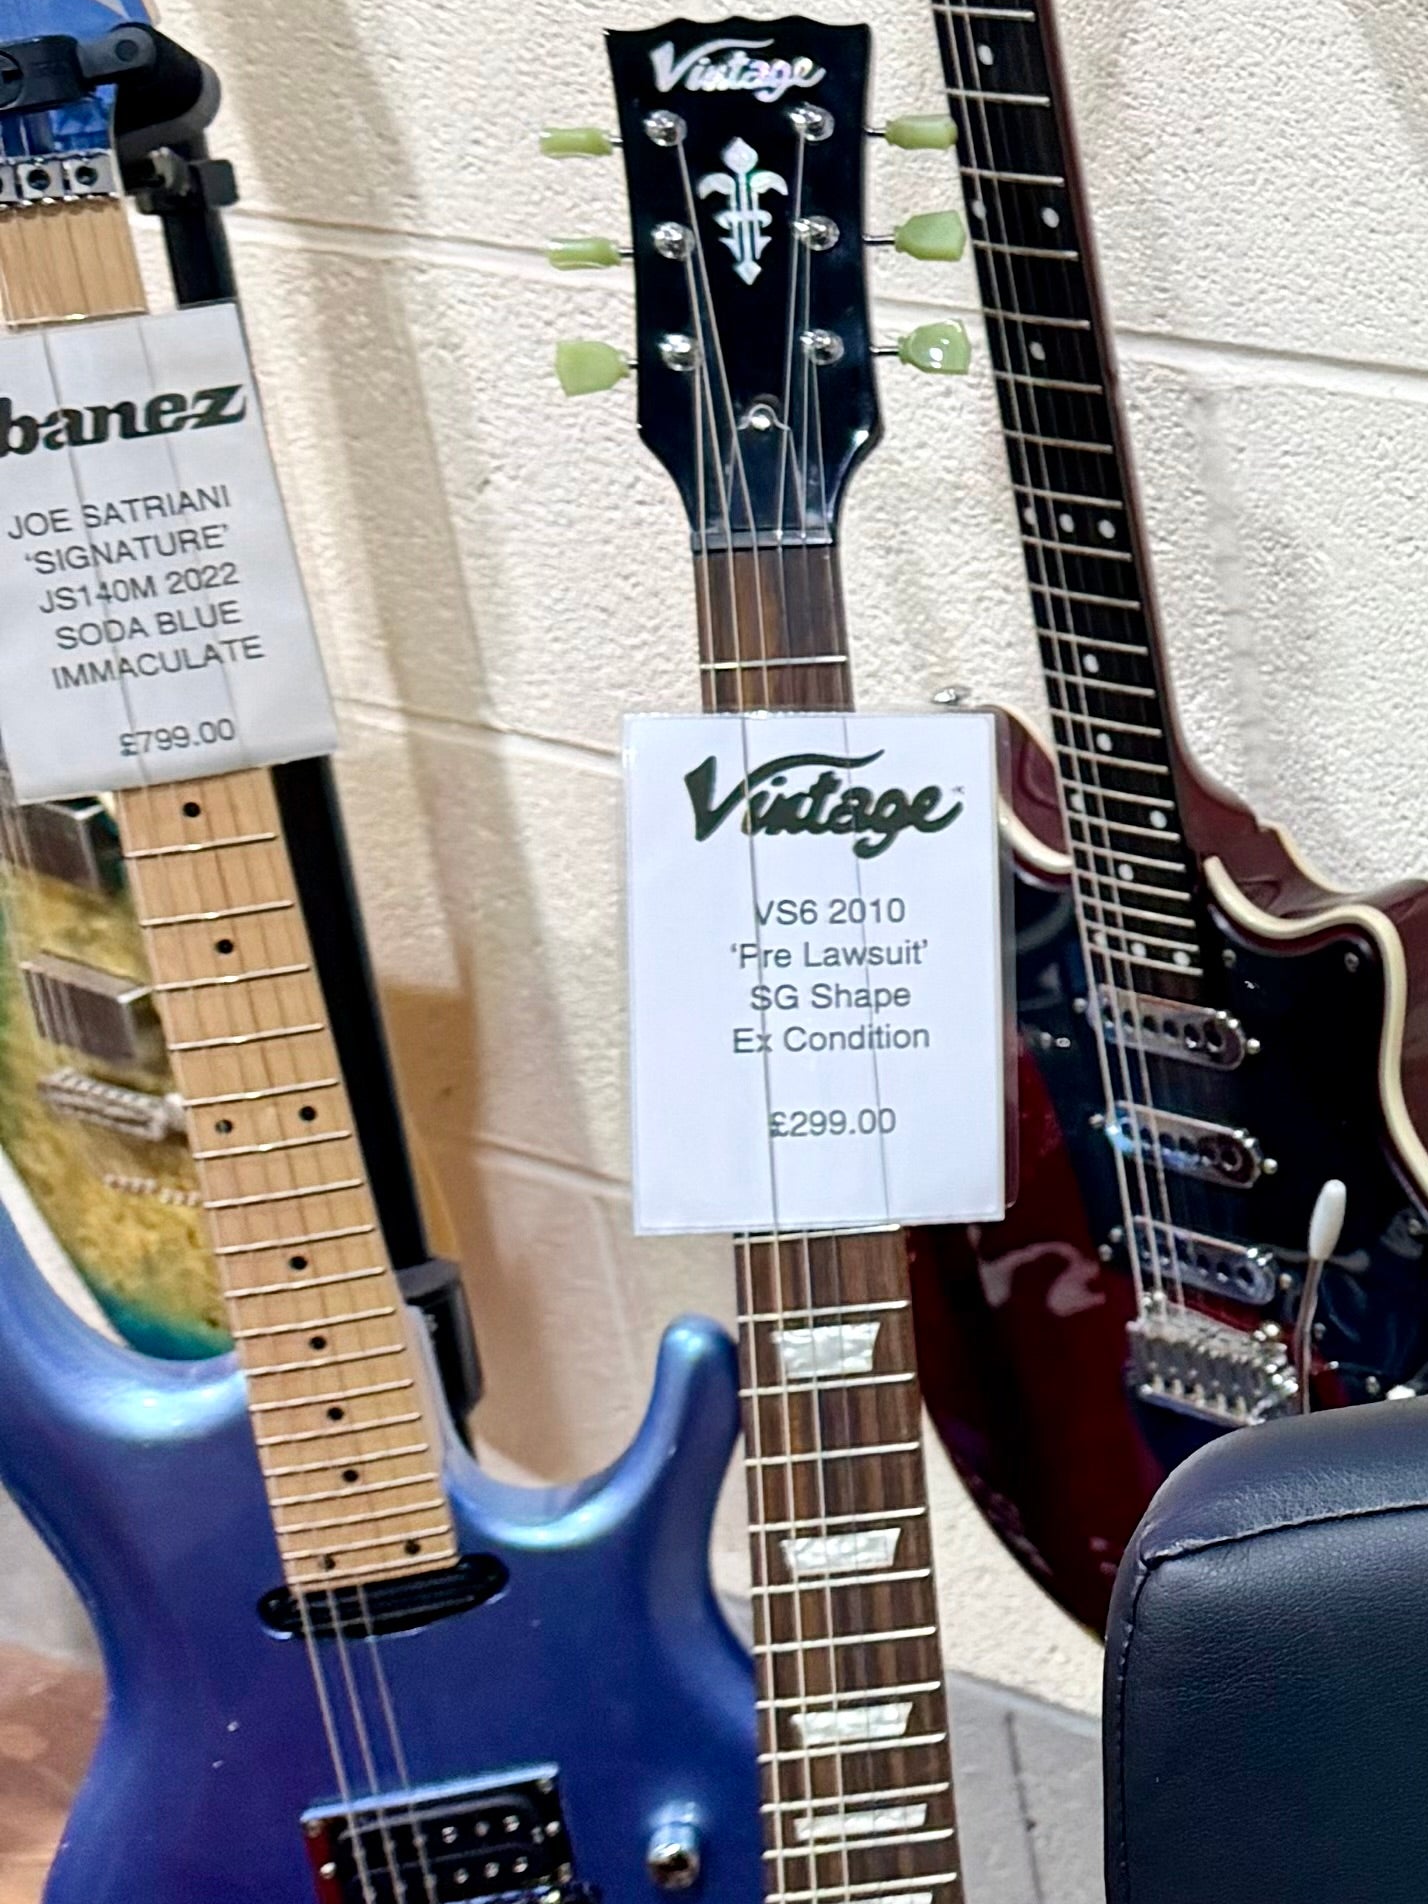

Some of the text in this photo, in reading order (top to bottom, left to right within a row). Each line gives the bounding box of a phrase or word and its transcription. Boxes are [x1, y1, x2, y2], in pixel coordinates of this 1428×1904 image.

[650, 38, 826, 103] Vintage
[0, 384, 246, 458] banez
[8, 485, 231, 540] JOE SATRIANI
[39, 562, 240, 614] JS140M 2022
[56, 600, 243, 650] SODA BLUE
[51, 635, 265, 690] IMMACULATE
[119, 718, 235, 757] £799.00
[684, 748, 963, 859] Vintage
[754, 897, 905, 925] VS6 2010
[751, 983, 911, 1014] SG Shape
[733, 1023, 930, 1053] Ex Condition
[768, 1107, 896, 1138] £299.00
